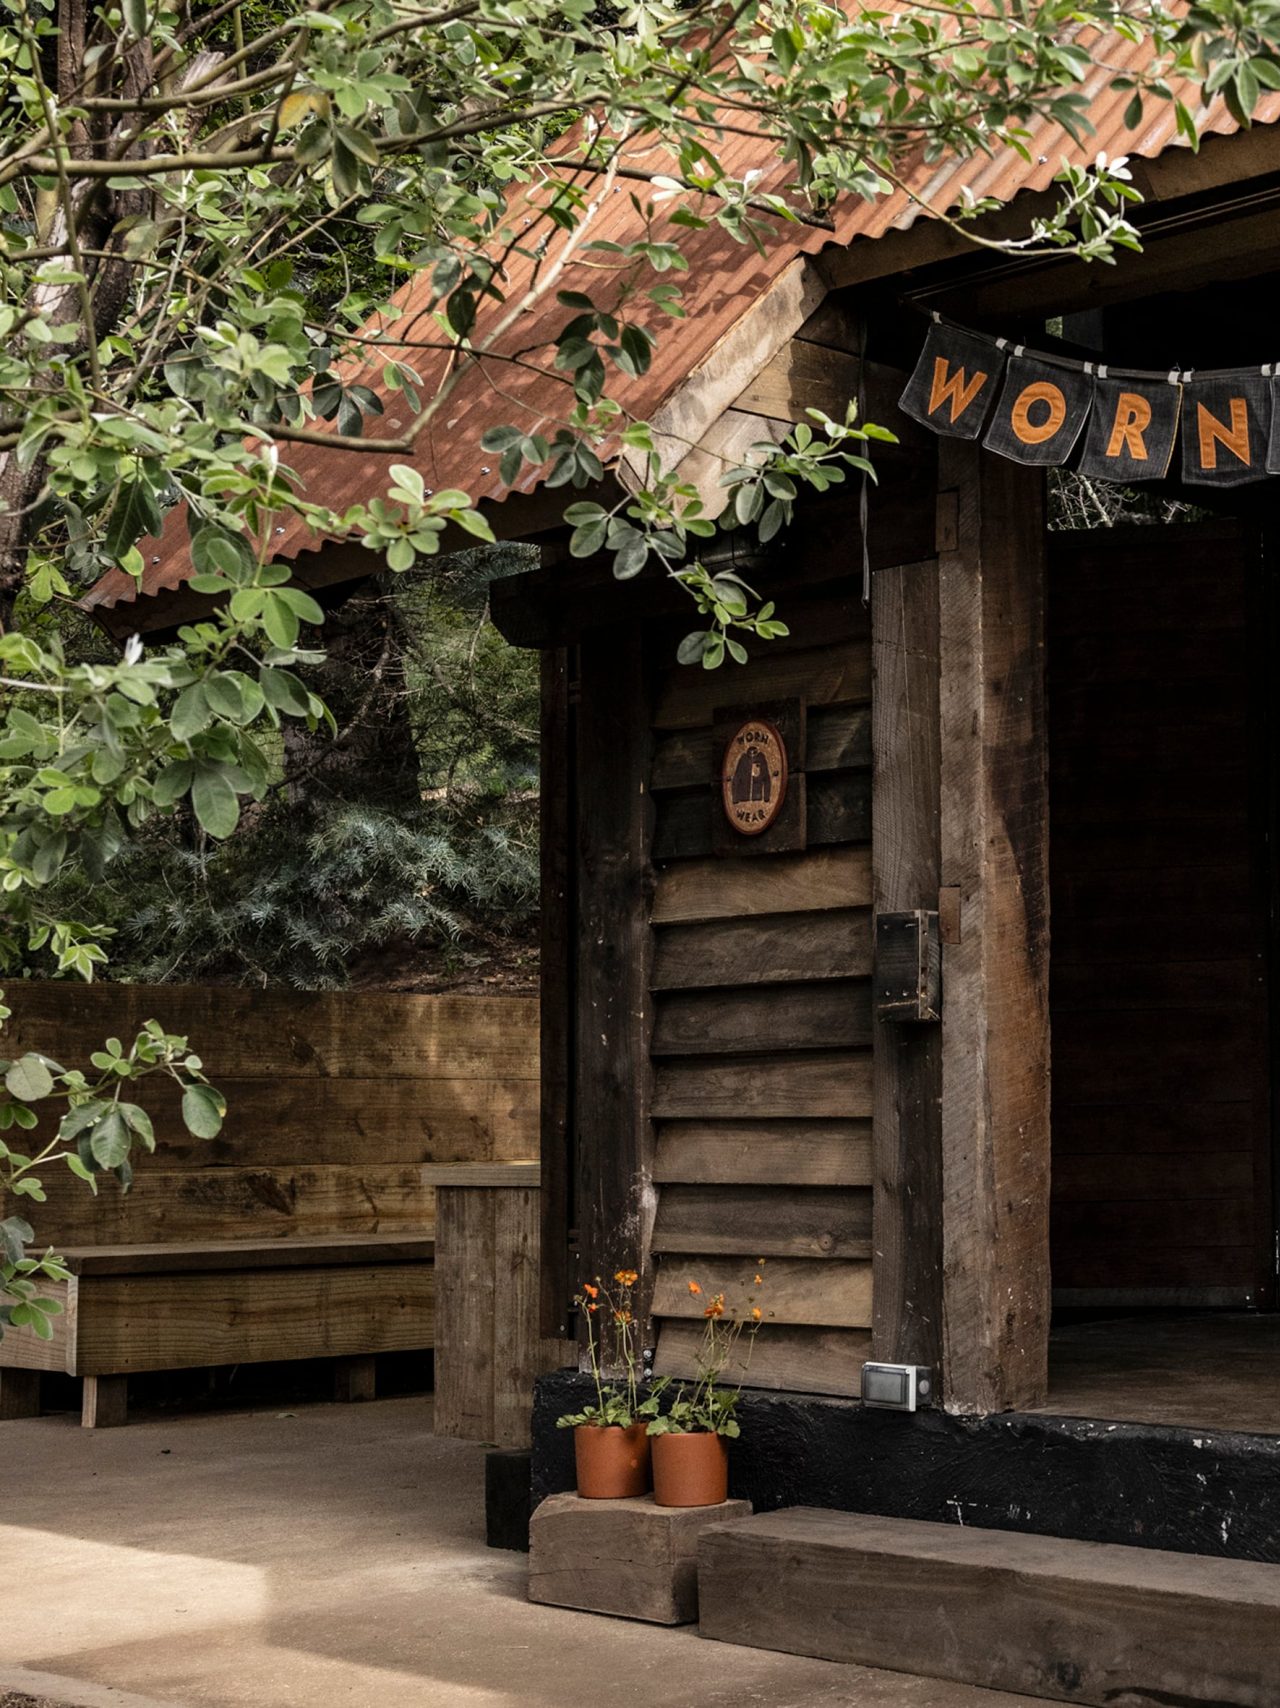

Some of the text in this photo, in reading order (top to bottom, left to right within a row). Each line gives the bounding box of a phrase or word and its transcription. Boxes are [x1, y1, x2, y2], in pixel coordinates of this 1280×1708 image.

[928, 356, 1251, 469] WORN
[737, 732, 769, 745] WORN
[736, 809, 766, 822] WEAR
